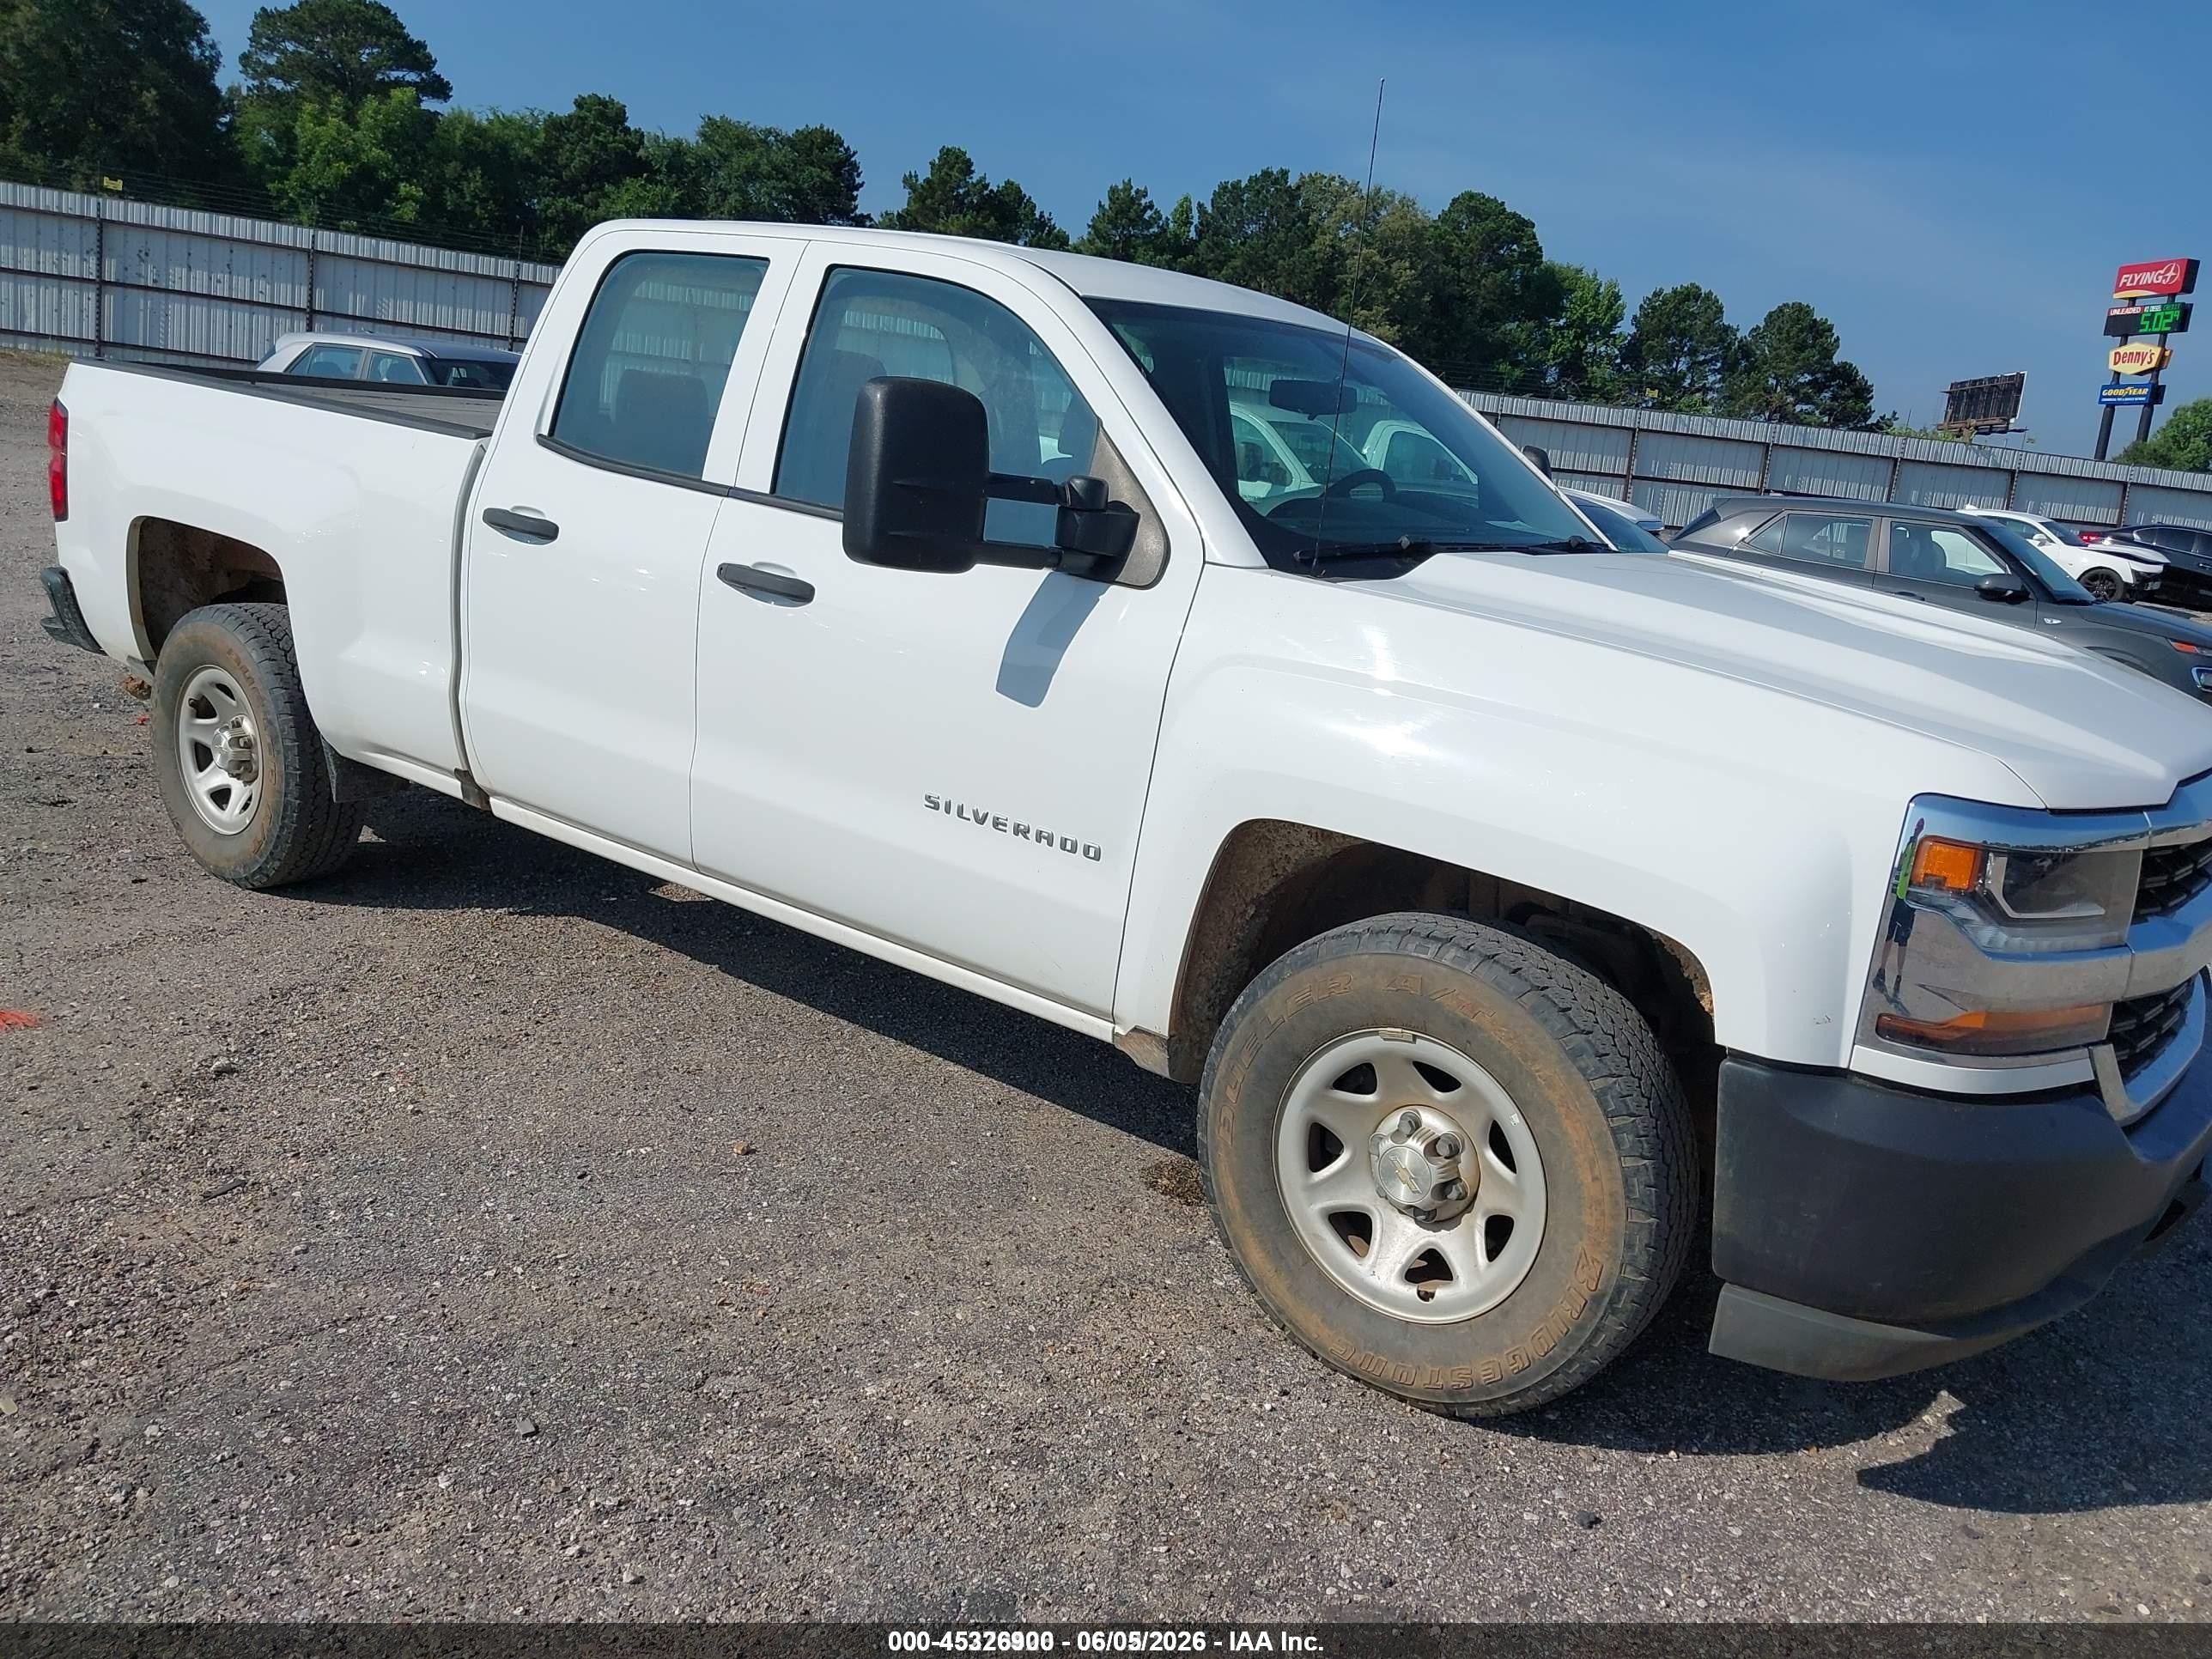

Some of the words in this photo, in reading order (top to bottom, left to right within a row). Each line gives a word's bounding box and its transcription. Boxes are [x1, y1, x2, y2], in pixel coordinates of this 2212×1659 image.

[2119, 271, 2163, 288] FLYING
[2110, 307, 2142, 315] UNLEADED
[2113, 349, 2154, 366] Denny's
[2102, 387, 2148, 396] GOODYEAR
[924, 792, 1102, 862] SILVERADO
[1329, 1247, 1604, 1390] BRIDGESTONE
